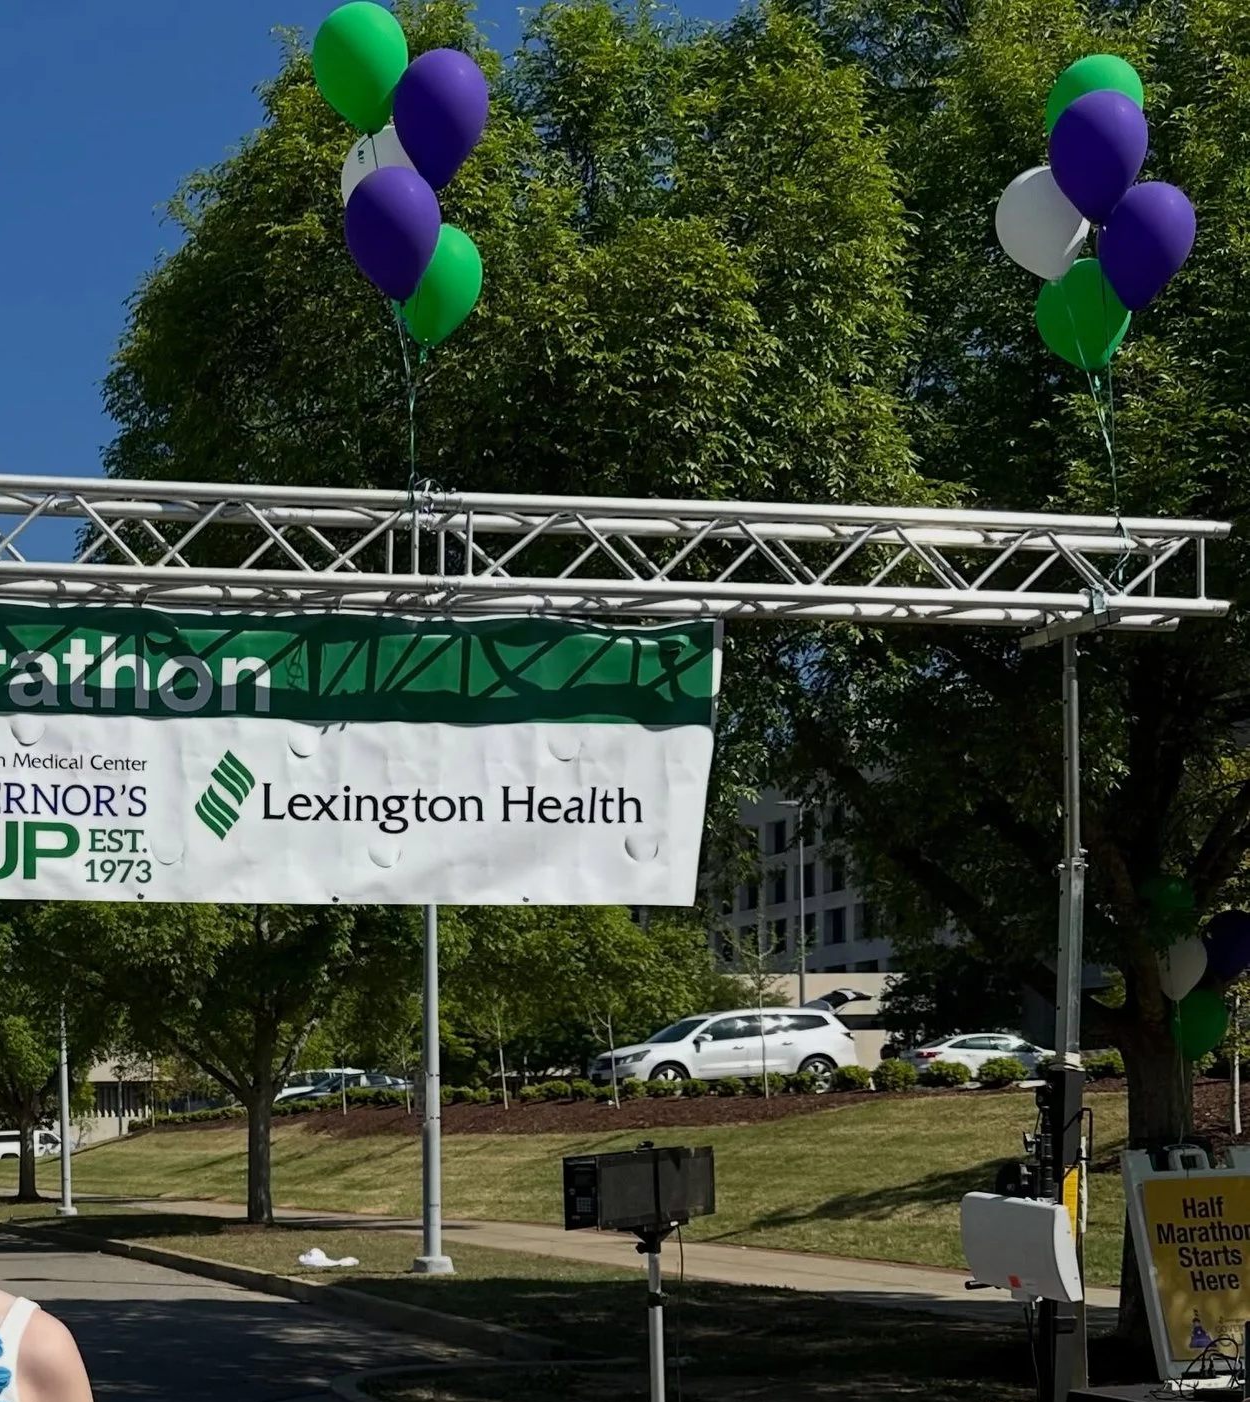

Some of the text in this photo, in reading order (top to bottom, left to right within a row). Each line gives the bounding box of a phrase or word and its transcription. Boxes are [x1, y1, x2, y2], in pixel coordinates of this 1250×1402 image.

[12, 752, 84, 770] Medical
[90, 754, 148, 771] Center
[261, 782, 644, 834] Lexington Health
[88, 828, 148, 854] EST.
[84, 859, 152, 884] 1973
[1181, 1196, 1223, 1219] Half
[1178, 1245, 1243, 1268] Starts
[1190, 1270, 1240, 1292] Here
